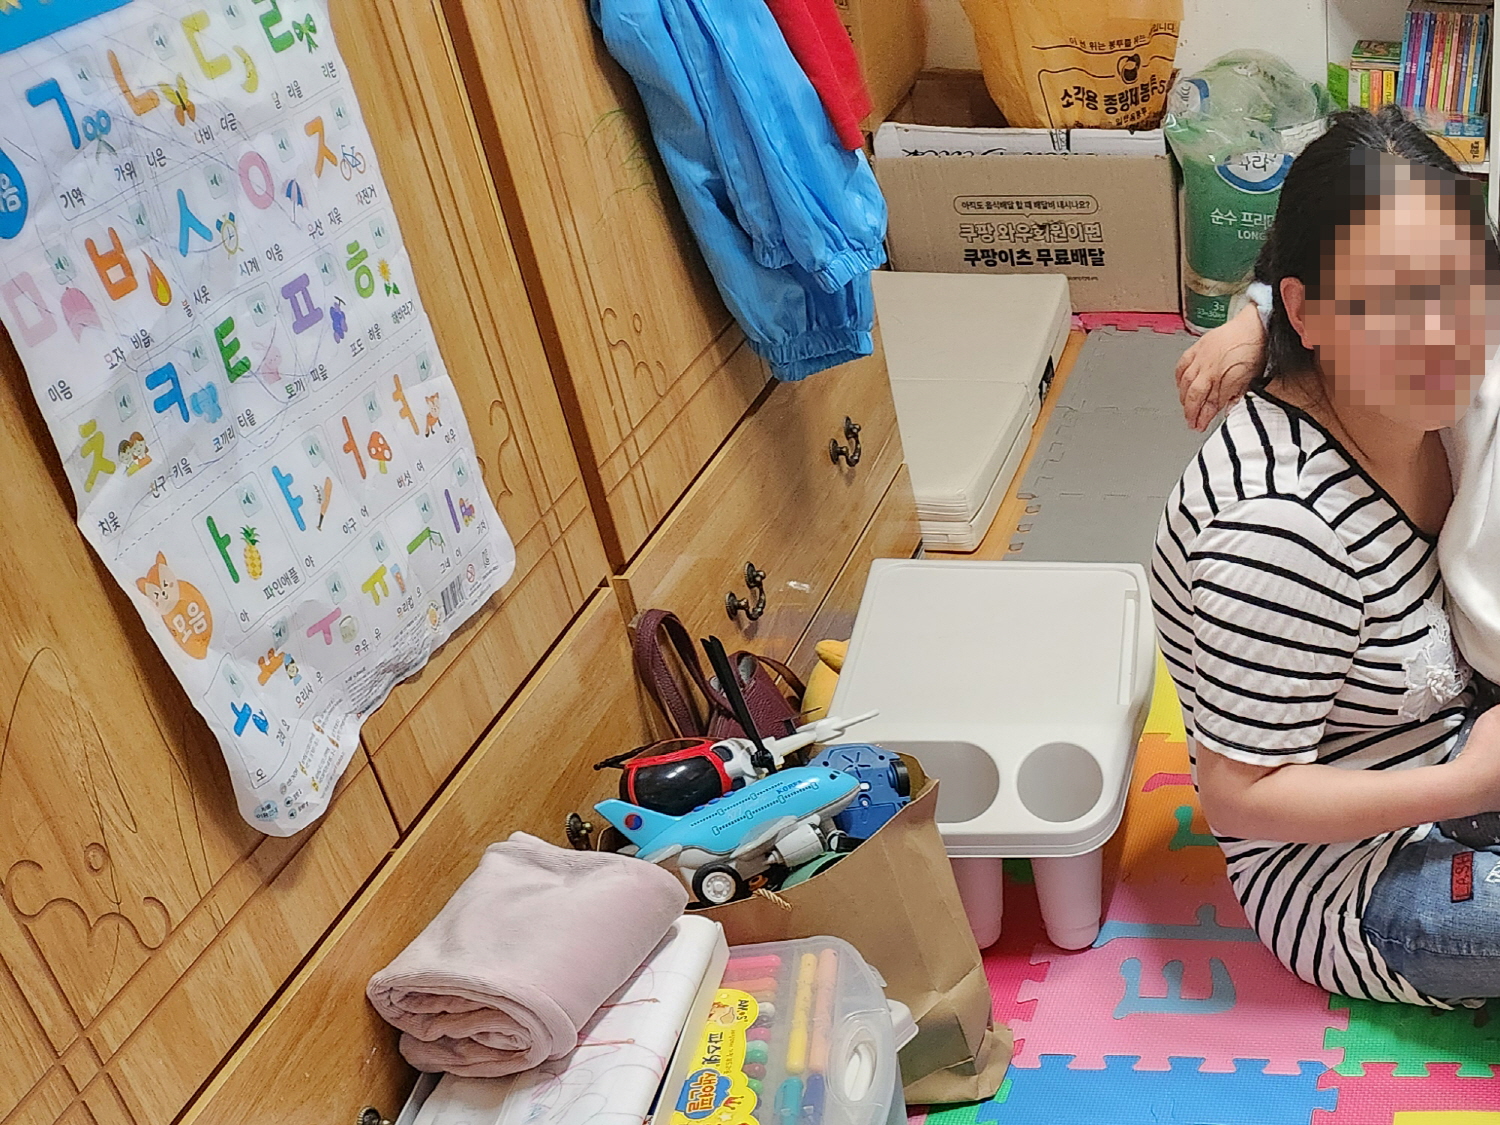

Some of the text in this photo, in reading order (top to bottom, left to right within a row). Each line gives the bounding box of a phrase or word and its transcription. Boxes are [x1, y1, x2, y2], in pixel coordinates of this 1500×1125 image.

[180, 9, 232, 79] ㄷ
[260, 0, 295, 53] ㄹ
[107, 49, 160, 116] ㄴ
[1060, 86, 1098, 111] 소각용
[25, 77, 81, 149] ㄱ
[114, 161, 137, 182] 가위
[146, 147, 167, 168] 니은
[304, 116, 338, 178] ㅈ
[60, 185, 86, 209] 기역
[238, 151, 275, 209] ㅇ
[179, 188, 214, 258] ㅅ
[961, 202, 984, 210] 아직도
[1057, 201, 1090, 210] 내시나요?
[1210, 208, 1238, 226] 순수
[959, 223, 1103, 243] 쿠팡 와우회원이면
[85, 227, 138, 301] ㅂ
[345, 240, 374, 298] ㅎ
[963, 249, 1105, 267] 쿠팡이츠 무료배달
[1, 271, 57, 347] ㅁ
[281, 273, 324, 335] ㅍ
[214, 316, 252, 384] ㅌ
[47, 379, 74, 403] 미음
[145, 362, 190, 424] ㅋ
[79, 419, 116, 493] ㅊ
[342, 416, 367, 480] ㅓ
[271, 465, 306, 531] ㅑ
[205, 515, 240, 584] ㅏ
[263, 565, 302, 601] 파인애플
[361, 564, 388, 606] ㅠ
[171, 600, 207, 645] 모음
[306, 607, 342, 646] ㅜ
[354, 639, 370, 657] 우유
[230, 701, 253, 738] ㅗ
[1455, 854, 1472, 899] LASH
[687, 1072, 721, 1118] 색연필
